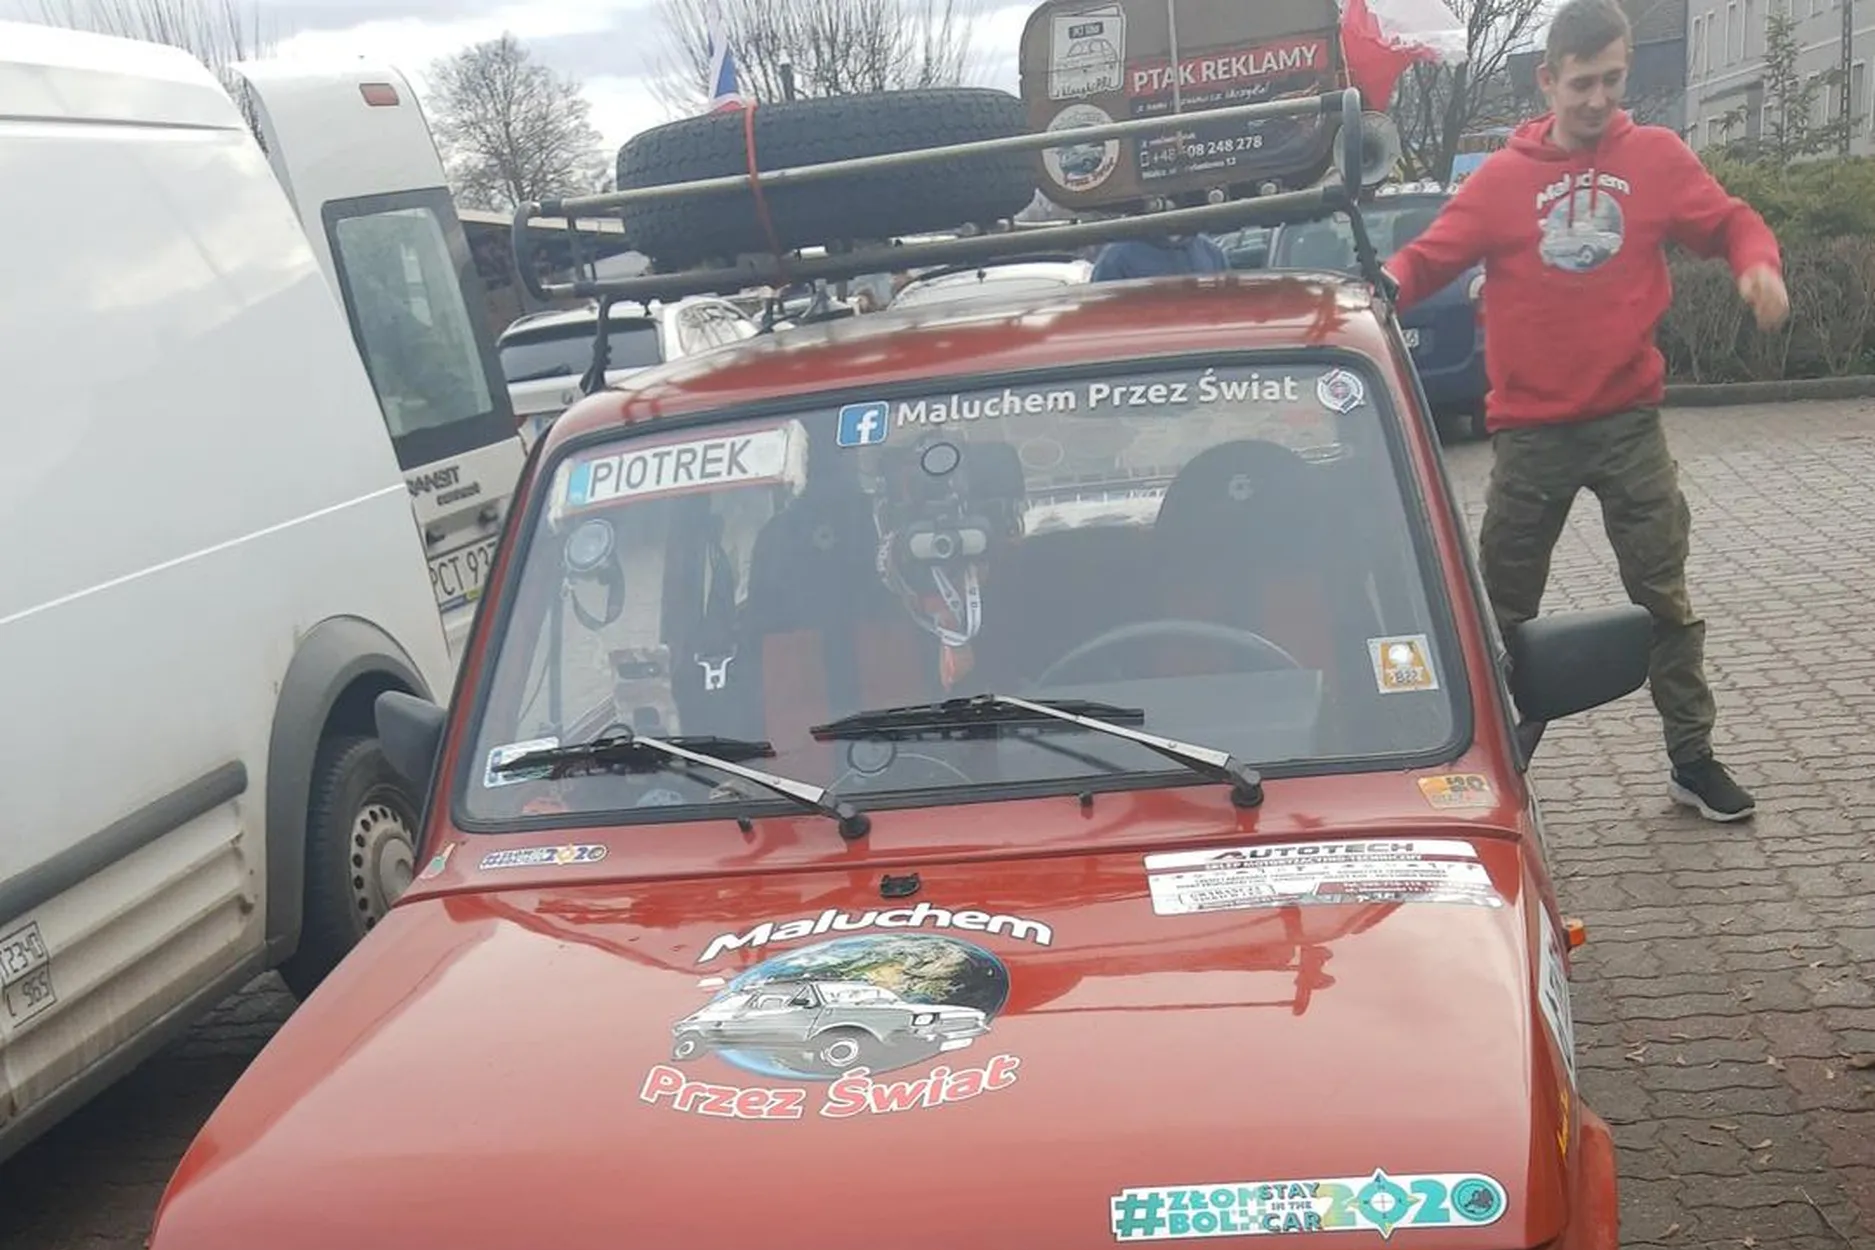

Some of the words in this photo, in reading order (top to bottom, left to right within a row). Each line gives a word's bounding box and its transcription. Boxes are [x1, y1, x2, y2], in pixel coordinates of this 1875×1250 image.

[1133, 62, 1196, 93] PTAK
[1202, 43, 1318, 83] REKLAMY
[1207, 138, 1234, 155] 248
[1236, 134, 1263, 151] 278
[896, 388, 1077, 427] Maluchem
[1088, 380, 1189, 409] Przez
[1198, 367, 1299, 402] Świat
[589, 438, 752, 498] PIOTREK
[1211, 841, 1415, 861] AUTOTECH
[697, 902, 1055, 964] Maluchem
[640, 1064, 807, 1120] Przez
[819, 1053, 1021, 1117] Świat
[1258, 1181, 1320, 1201] STAY
[1262, 1210, 1324, 1233] CAR
